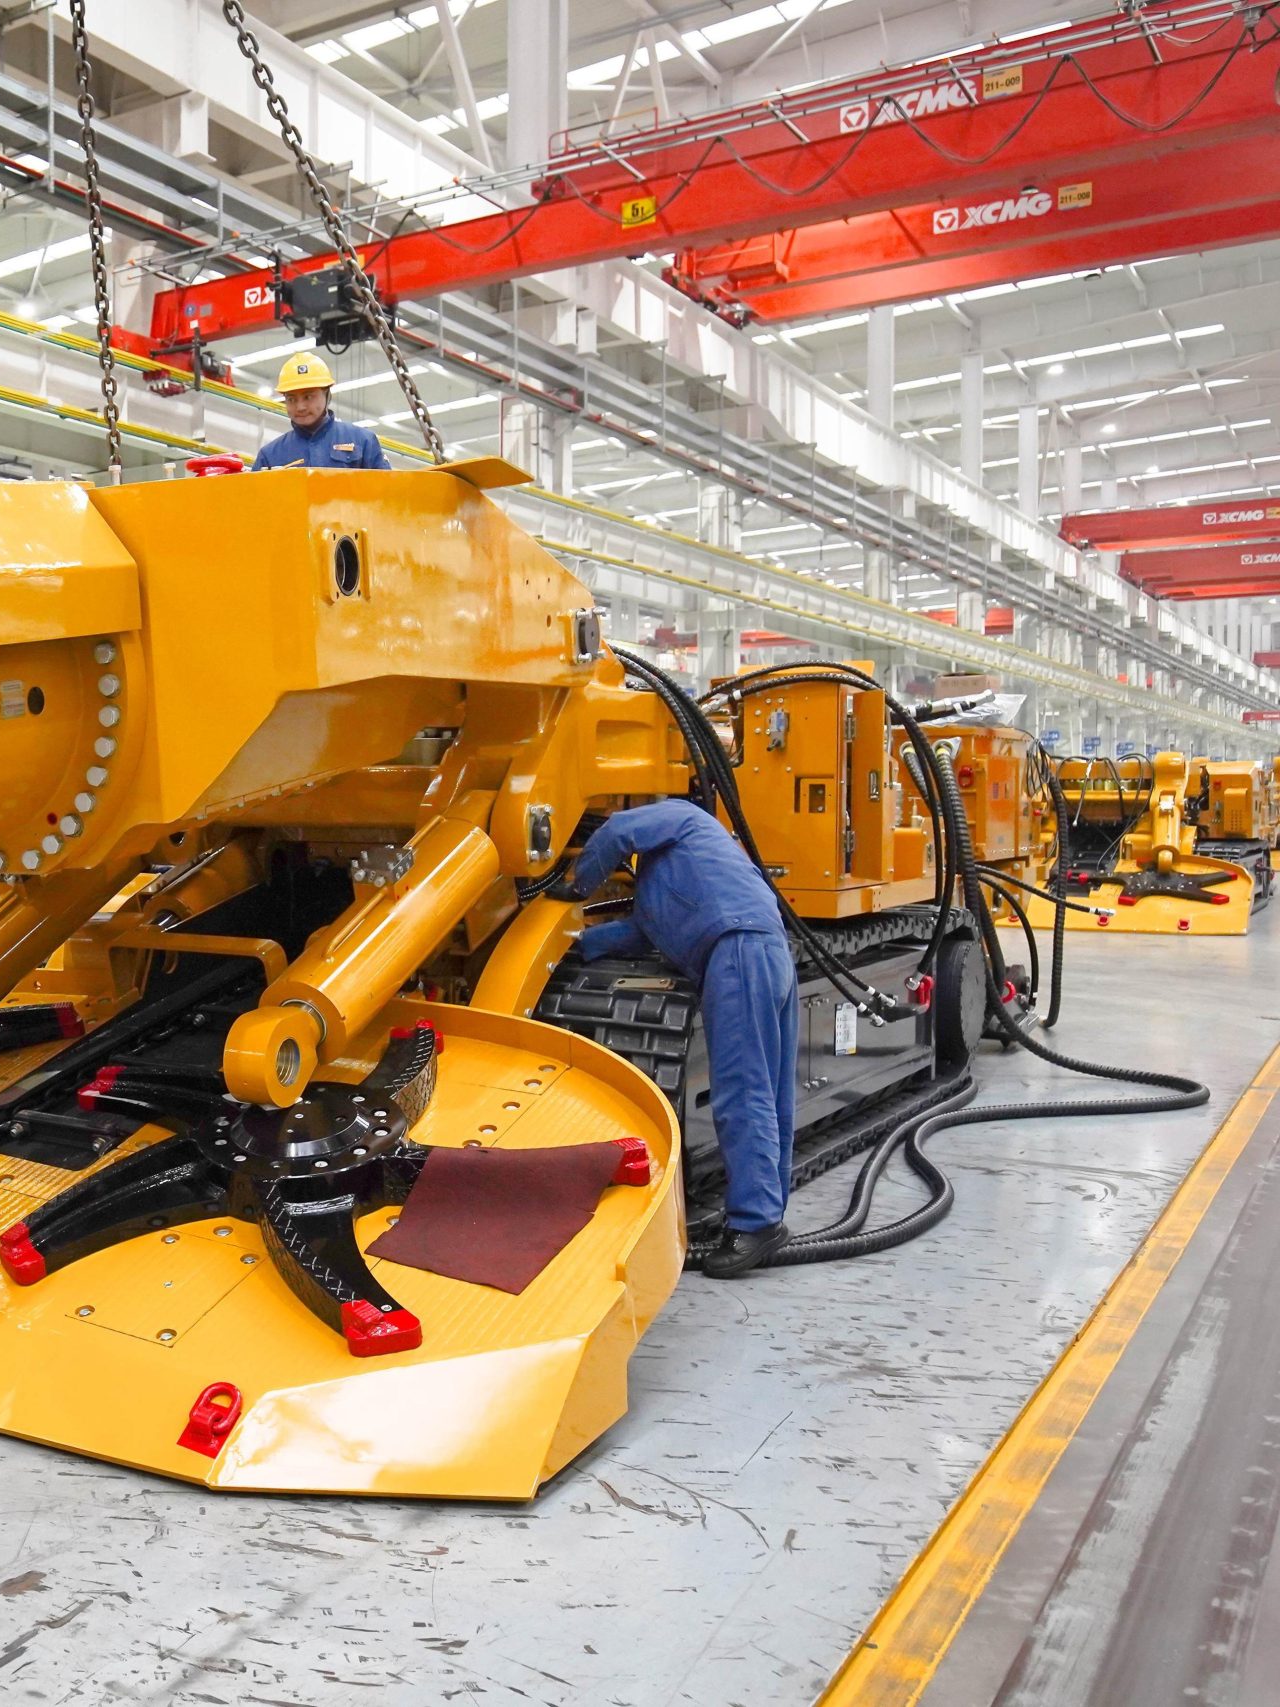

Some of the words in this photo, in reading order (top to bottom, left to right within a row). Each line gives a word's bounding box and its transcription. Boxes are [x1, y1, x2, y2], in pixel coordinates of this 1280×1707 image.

[871, 79, 978, 127] XCMG
[958, 192, 1053, 230] XCMG
[1217, 510, 1265, 524] XCMG
